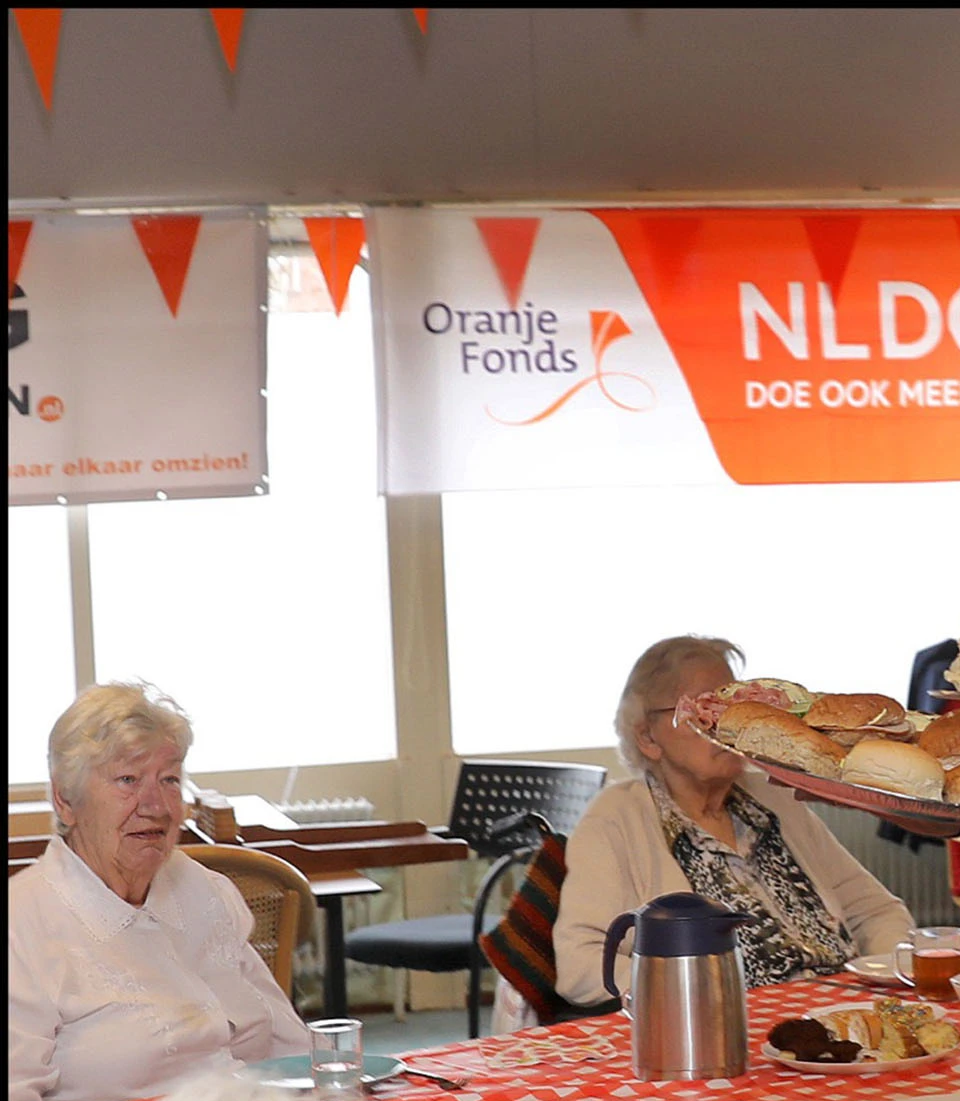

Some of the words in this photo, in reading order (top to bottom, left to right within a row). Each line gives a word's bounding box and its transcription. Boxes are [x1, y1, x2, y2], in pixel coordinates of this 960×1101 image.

[423, 302, 558, 345] Oranje
[461, 339, 578, 374] Fonds
[745, 380, 812, 409] DOE
[819, 379, 891, 408] OOK
[8, 462, 54, 478] aar
[62, 457, 142, 478] elkaar
[150, 452, 248, 473] omzien!
